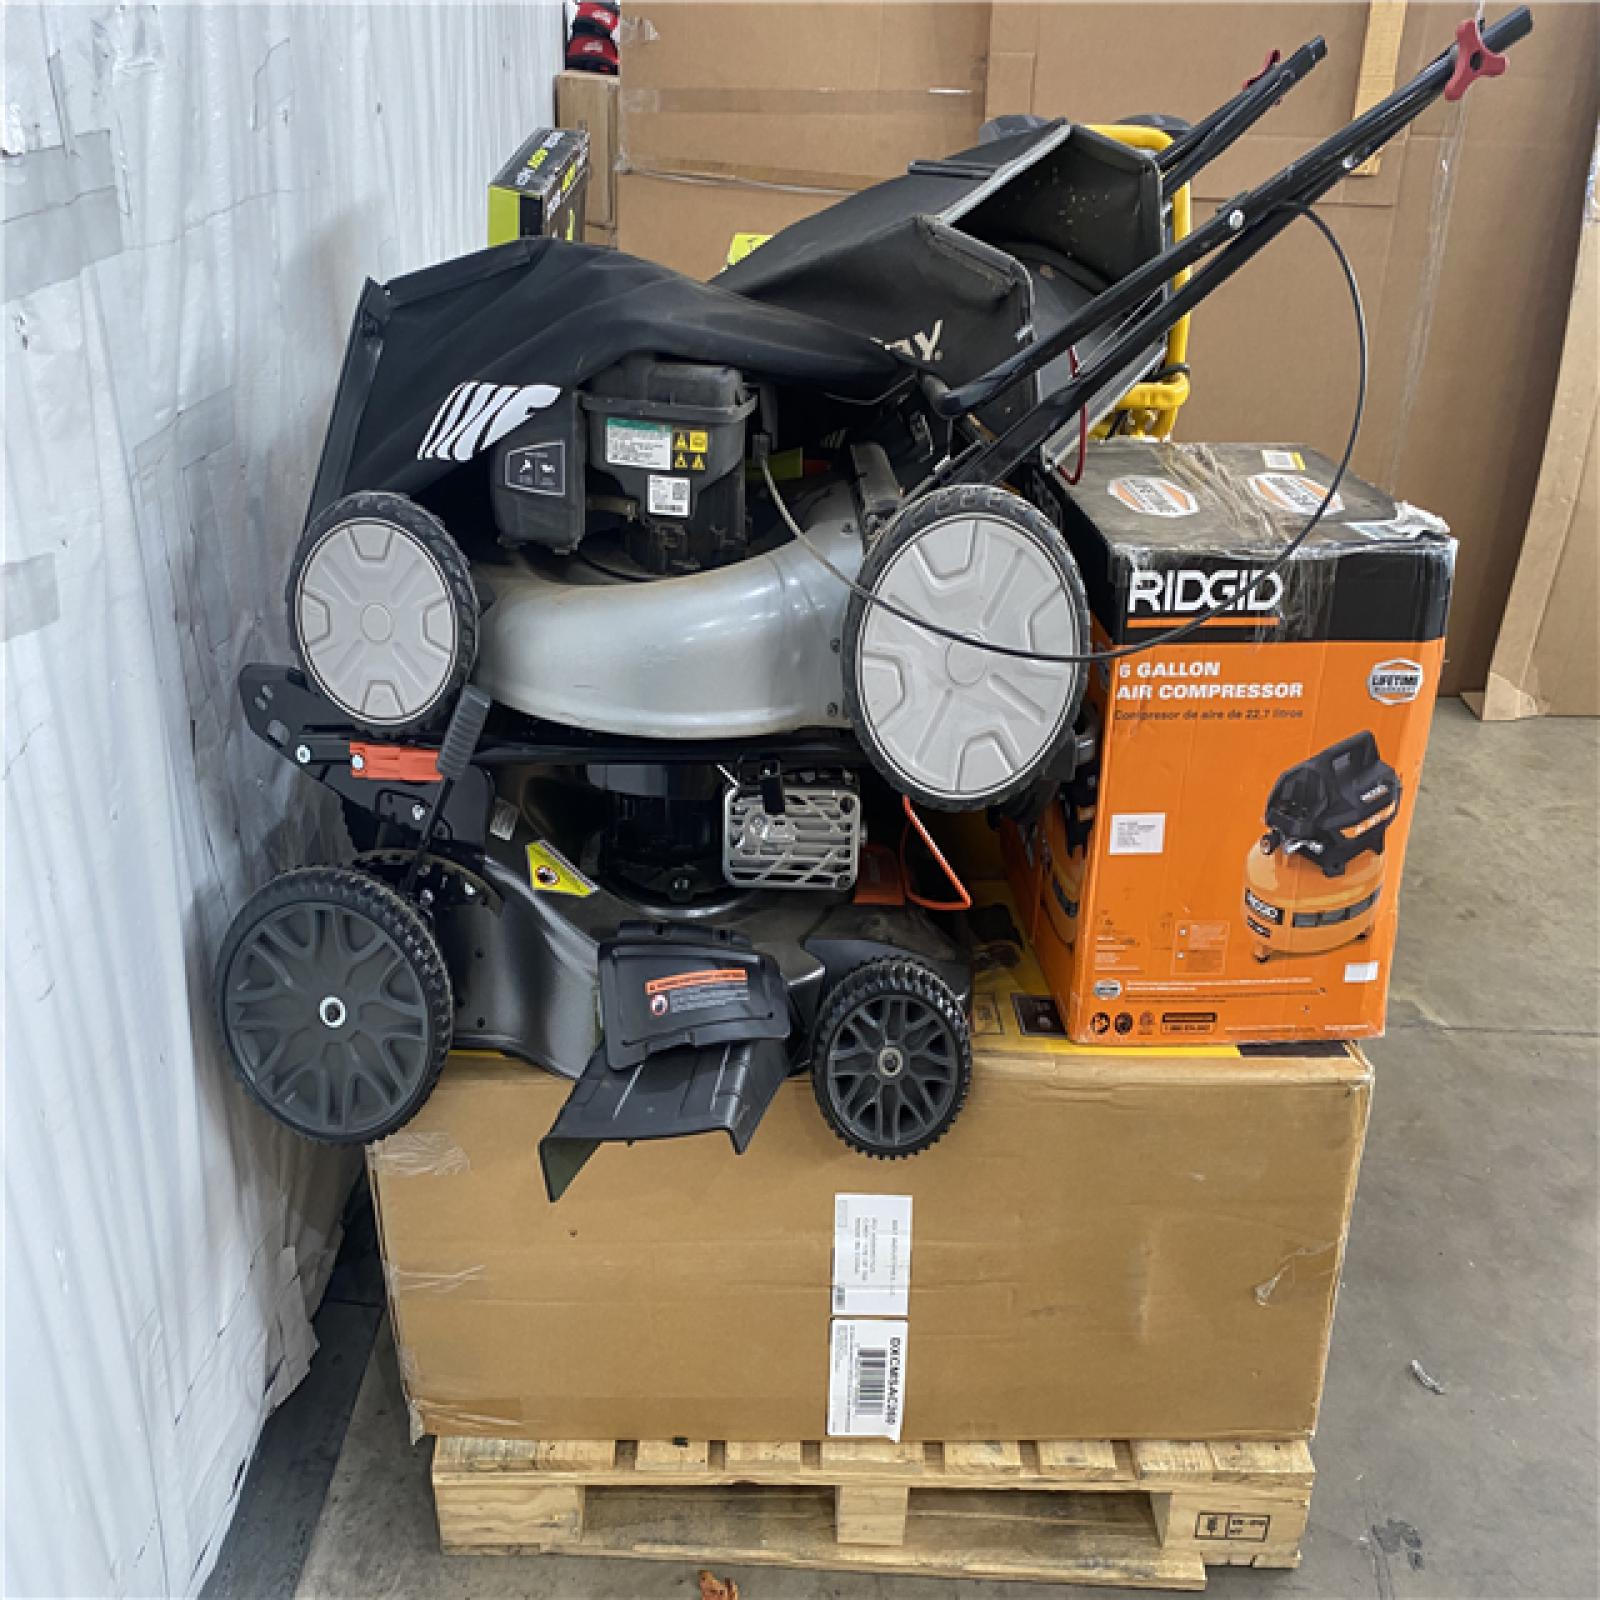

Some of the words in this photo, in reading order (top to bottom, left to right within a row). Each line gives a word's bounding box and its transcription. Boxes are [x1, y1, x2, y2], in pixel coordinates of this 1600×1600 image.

[1127, 569, 1284, 613] RIDGID
[1119, 663, 1131, 678] 6
[1136, 661, 1221, 678] GALLON
[1116, 684, 1153, 700] AIR
[1159, 682, 1304, 700] COMPRESSOR
